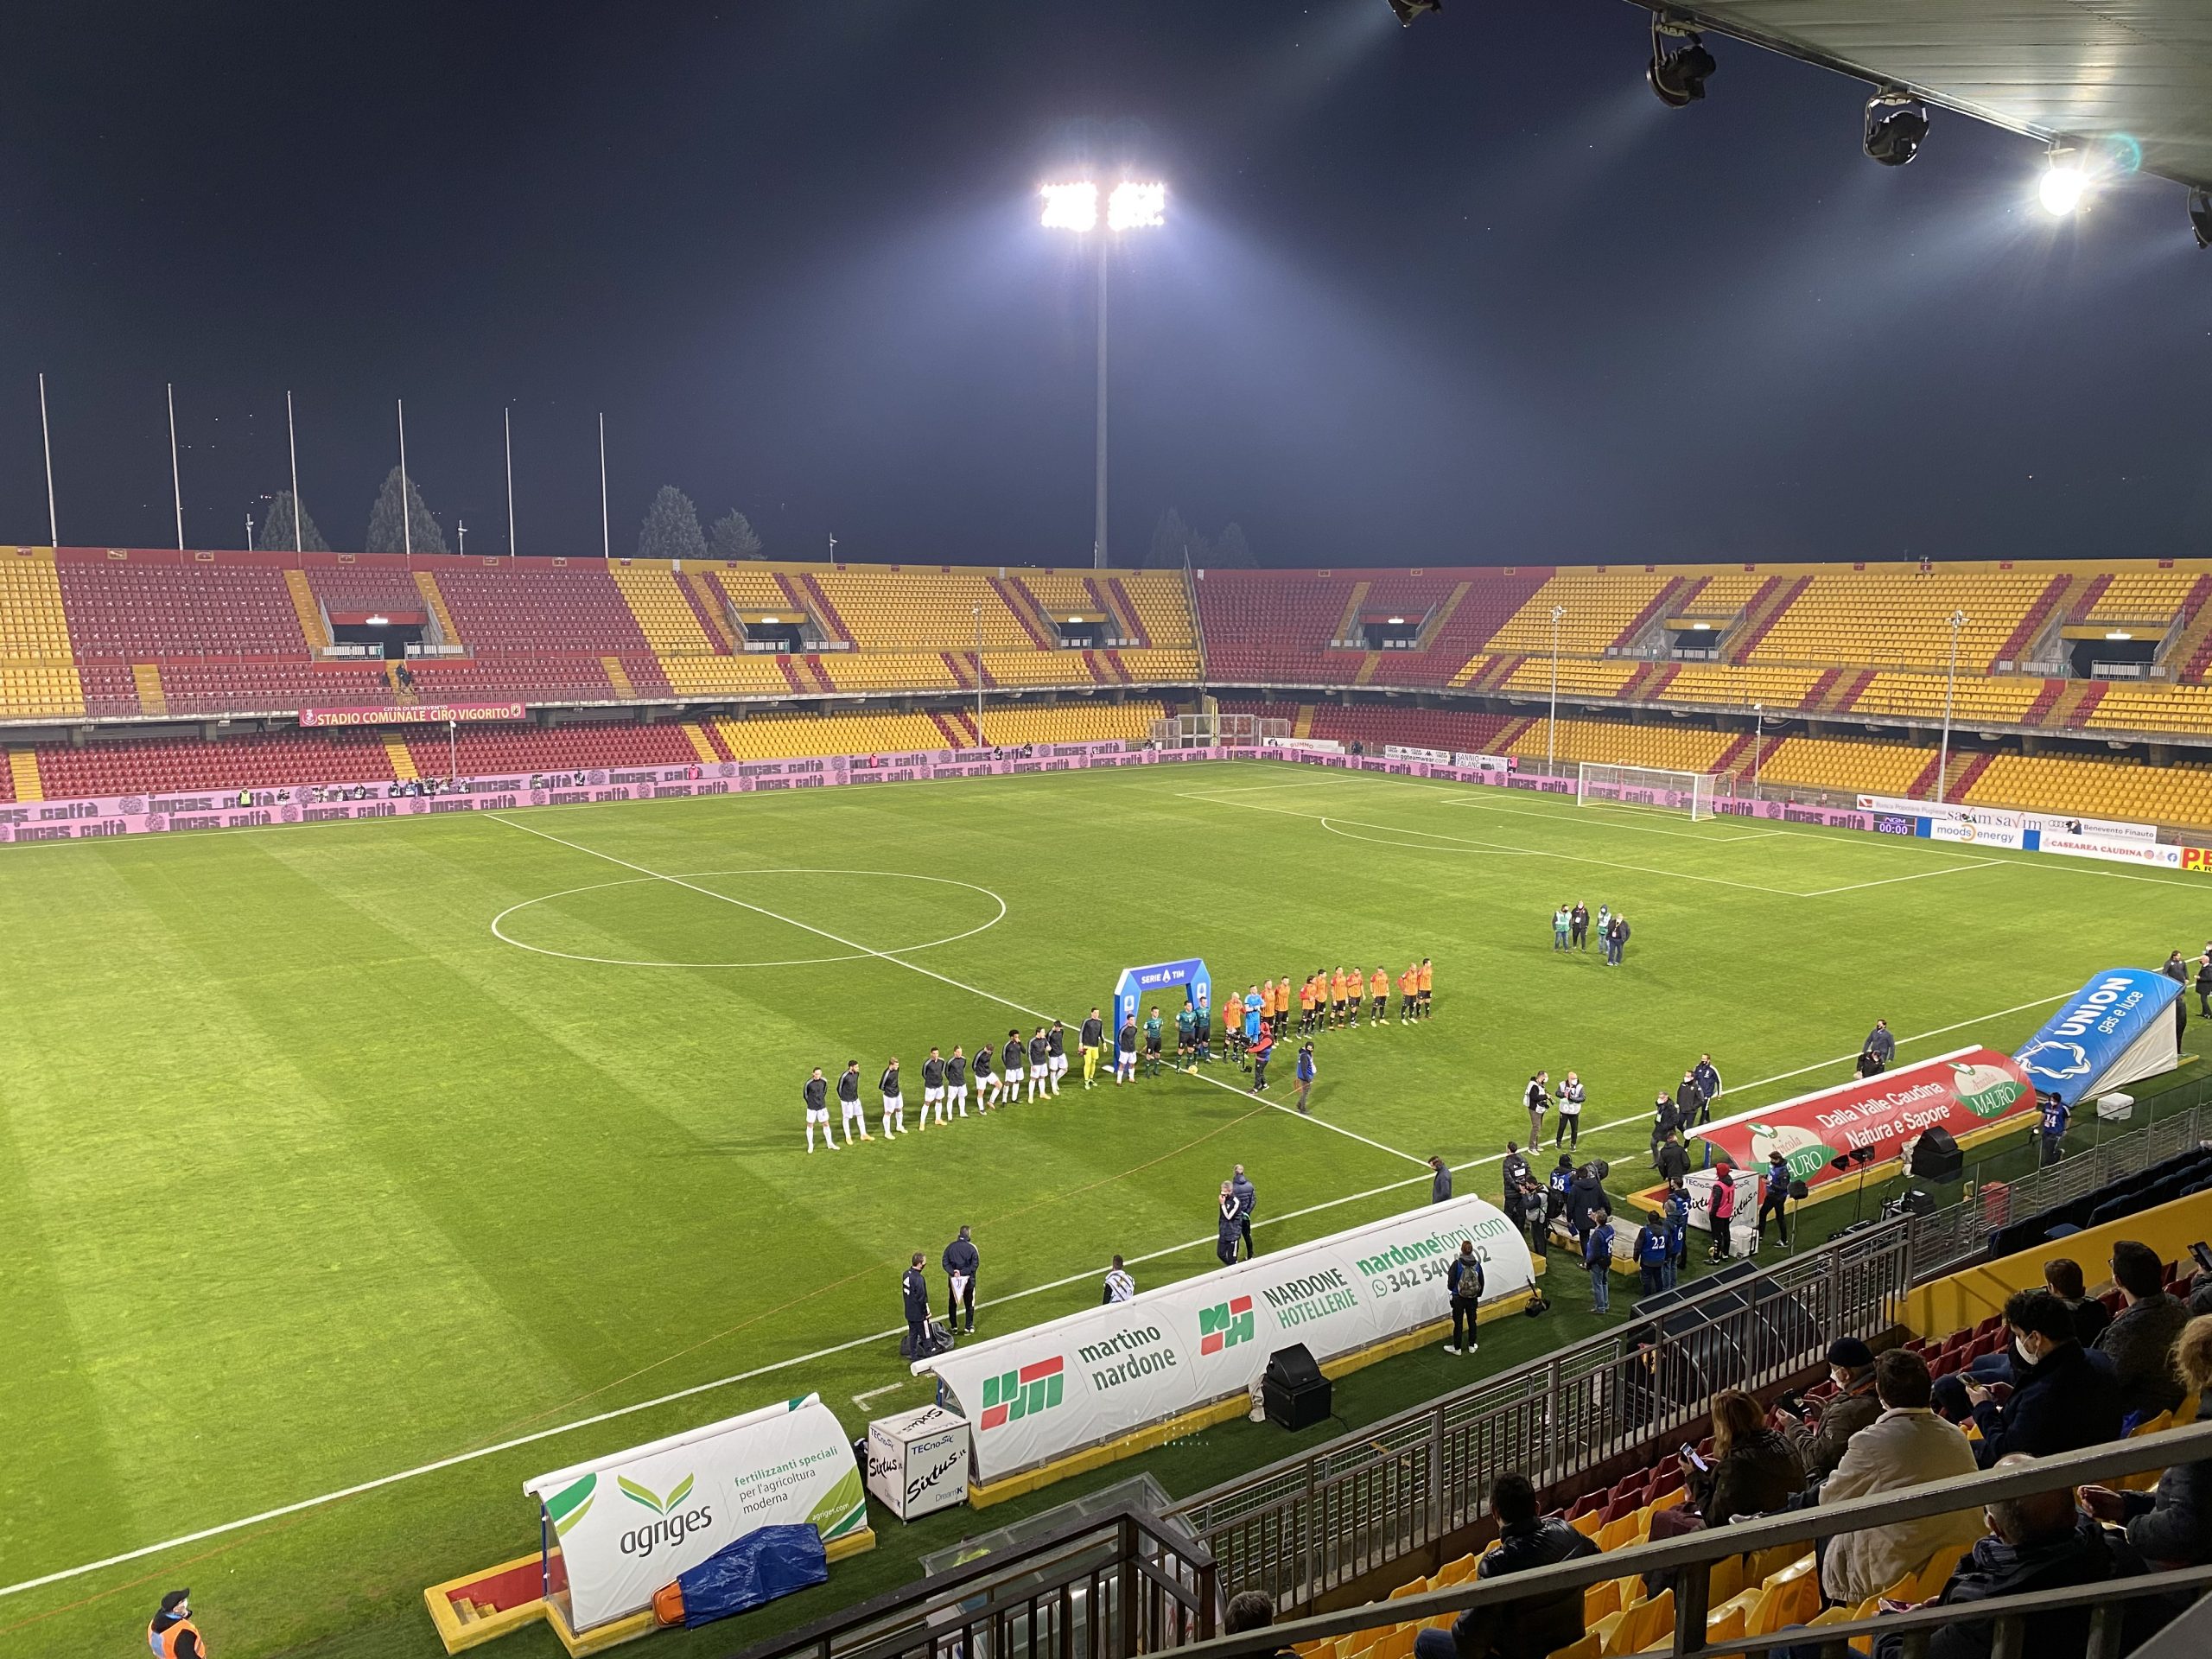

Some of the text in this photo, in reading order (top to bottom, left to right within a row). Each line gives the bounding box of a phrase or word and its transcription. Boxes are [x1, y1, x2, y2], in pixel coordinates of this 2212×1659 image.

[317, 708, 509, 725] STADIO COMUNALE CIRO VIGORITO
[955, 748, 991, 763] incas
[1053, 743, 1087, 757] incas
[1386, 753, 1448, 764] www.ggteamwear.com
[1457, 753, 1479, 761] SANNIO
[608, 768, 658, 785] incas
[738, 760, 782, 776] incas
[850, 769, 882, 784] incas
[933, 764, 963, 779] incas
[469, 776, 522, 793] incas
[654, 781, 692, 798] incas
[755, 775, 791, 791] incas
[149, 792, 213, 813] incas
[550, 787, 590, 804] incas
[302, 803, 350, 821] incas
[429, 796, 474, 813] incas
[169, 810, 221, 831] incas
[1783, 804, 1824, 825] incas
[14, 821, 72, 841] incas
[1879, 823, 1908, 835] 00:00
[1937, 826, 2014, 843] moods energy
[2083, 823, 2154, 838] Benevento Finauto
[2101, 846, 2142, 857] CAUDINA
[1141, 974, 1161, 984] SERIE
[1173, 969, 1185, 980] TIM
[2053, 977, 2134, 1036] UNION
[2097, 990, 2144, 1035] gas e luce
[1815, 1082, 1946, 1129] Dalla Valle Caudina
[1971, 1086, 2016, 1116] MAURO
[1845, 1104, 1951, 1151] Natura e Sapore
[1786, 1151, 1823, 1178] AURO
[1551, 1176, 1565, 1192] 28
[1355, 1217, 1510, 1277] nardoneforni.com
[1651, 1236, 1666, 1250] 22
[1262, 1267, 1348, 1309] NARDONE
[1387, 1267, 1421, 1294] 342
[1277, 1287, 1359, 1330] HOTELLERIE
[1077, 1326, 1161, 1363] martino
[1091, 1348, 1177, 1391] nardone
[734, 1446, 838, 1487] fertilizzanti speciali
[739, 1469, 816, 1503] per l'agricoltura
[743, 1492, 788, 1515] moderna
[620, 1505, 713, 1558] agriges
